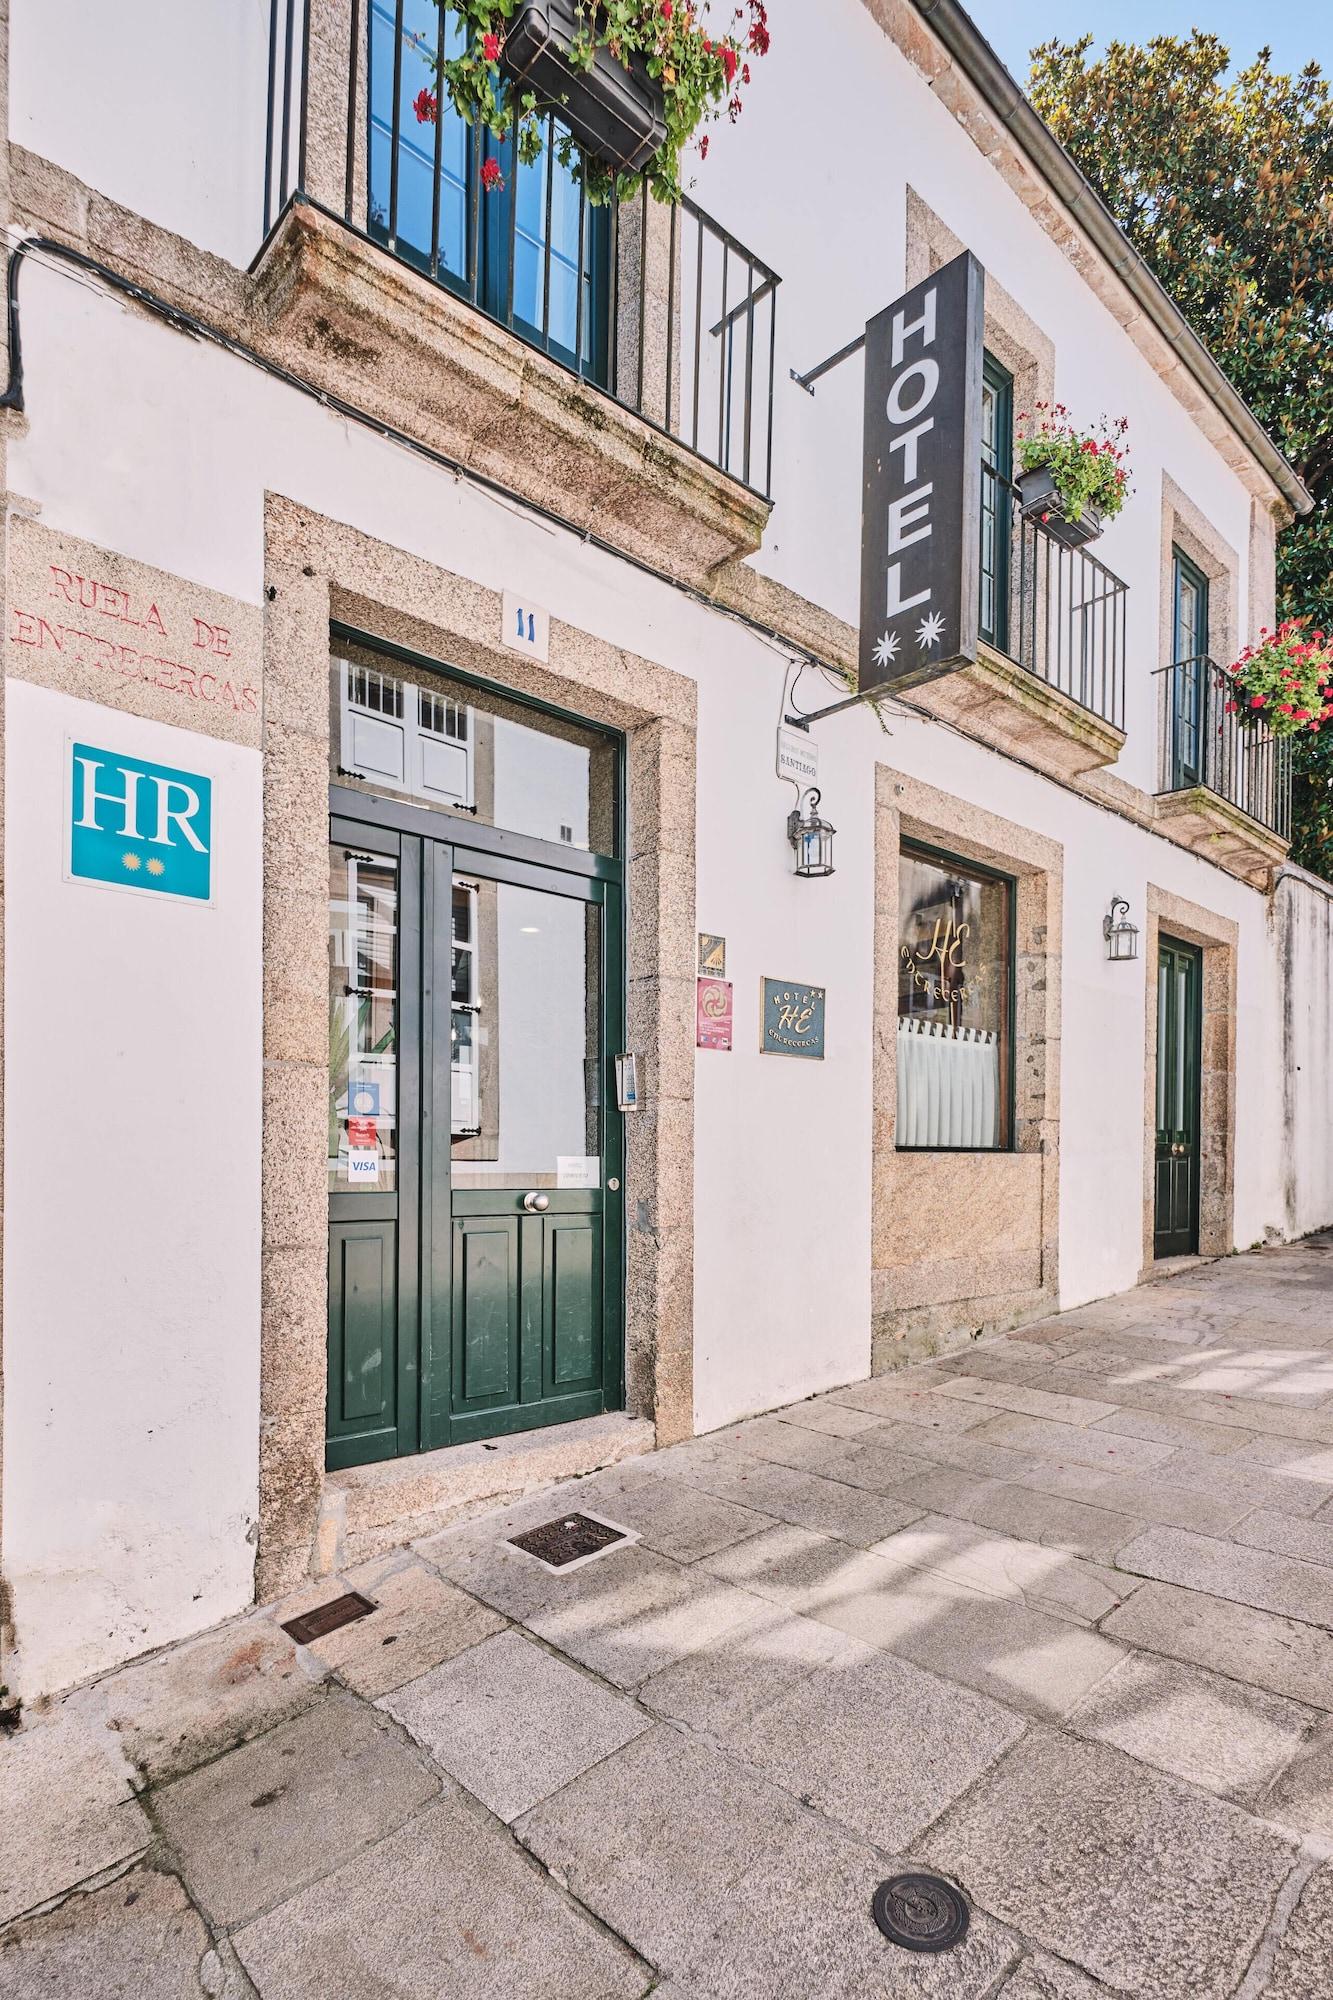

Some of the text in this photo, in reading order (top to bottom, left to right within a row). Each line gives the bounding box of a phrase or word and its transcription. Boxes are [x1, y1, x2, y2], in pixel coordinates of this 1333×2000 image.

[886, 287, 939, 619] HOTEL
[49, 565, 231, 657] RUELA DE
[516, 608, 535, 643] 11
[10, 609, 258, 713] ENTRECERCAS
[780, 753, 816, 776] SANTIAGO
[73, 756, 209, 854] HR
[774, 992, 816, 1010] HOTEL
[352, 1161, 376, 1171] VISA
